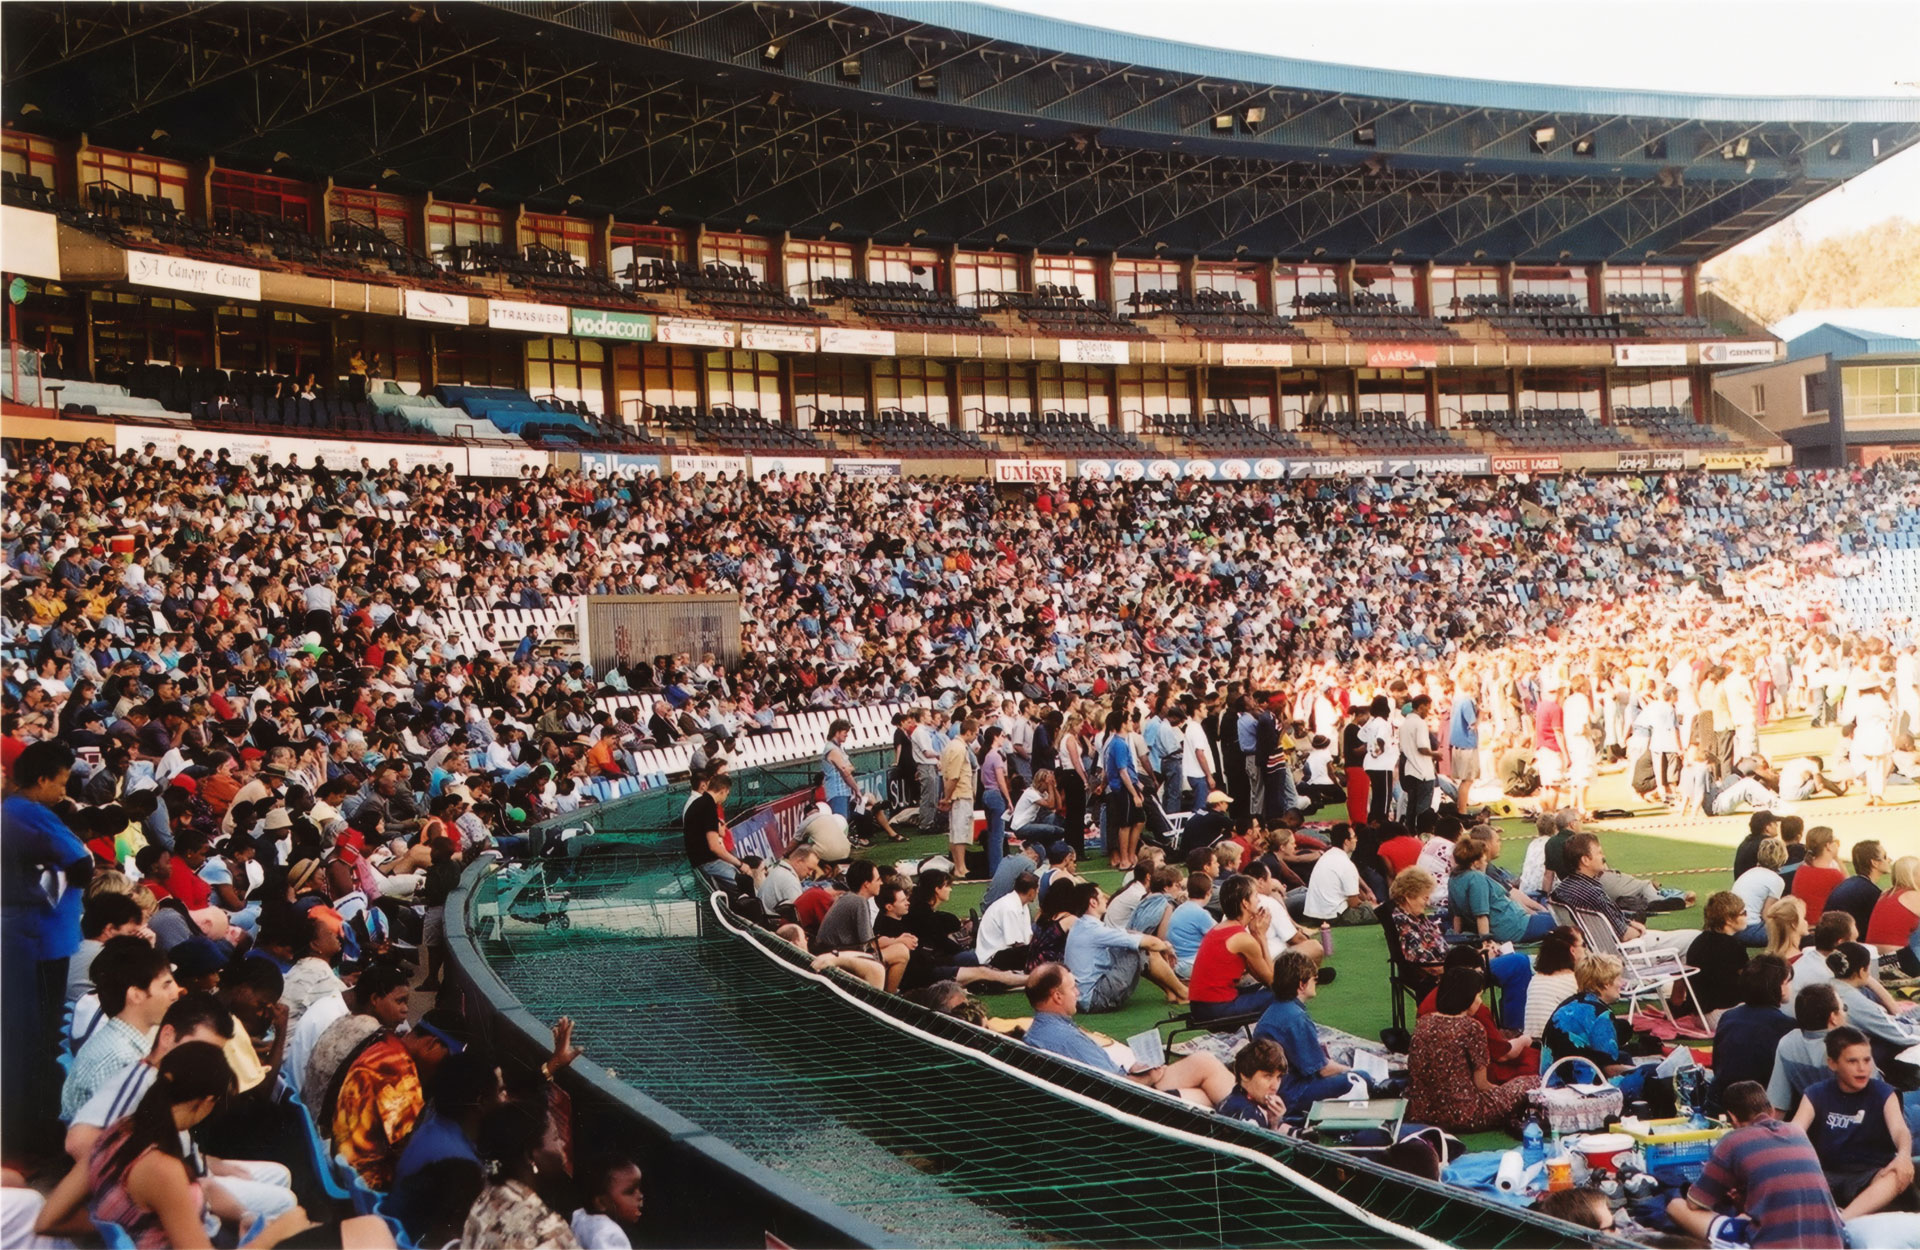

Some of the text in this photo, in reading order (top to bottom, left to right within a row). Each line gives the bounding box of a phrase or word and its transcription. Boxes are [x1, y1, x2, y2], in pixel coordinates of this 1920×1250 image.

[573, 312, 648, 338] vodacom
[1387, 350, 1417, 362] ABSA
[581, 453, 660, 480] Telkom
[1312, 461, 1383, 475] TRANSNET
[1413, 459, 1487, 472] TRANSNET
[1494, 459, 1559, 470] CASTLE LAGER
